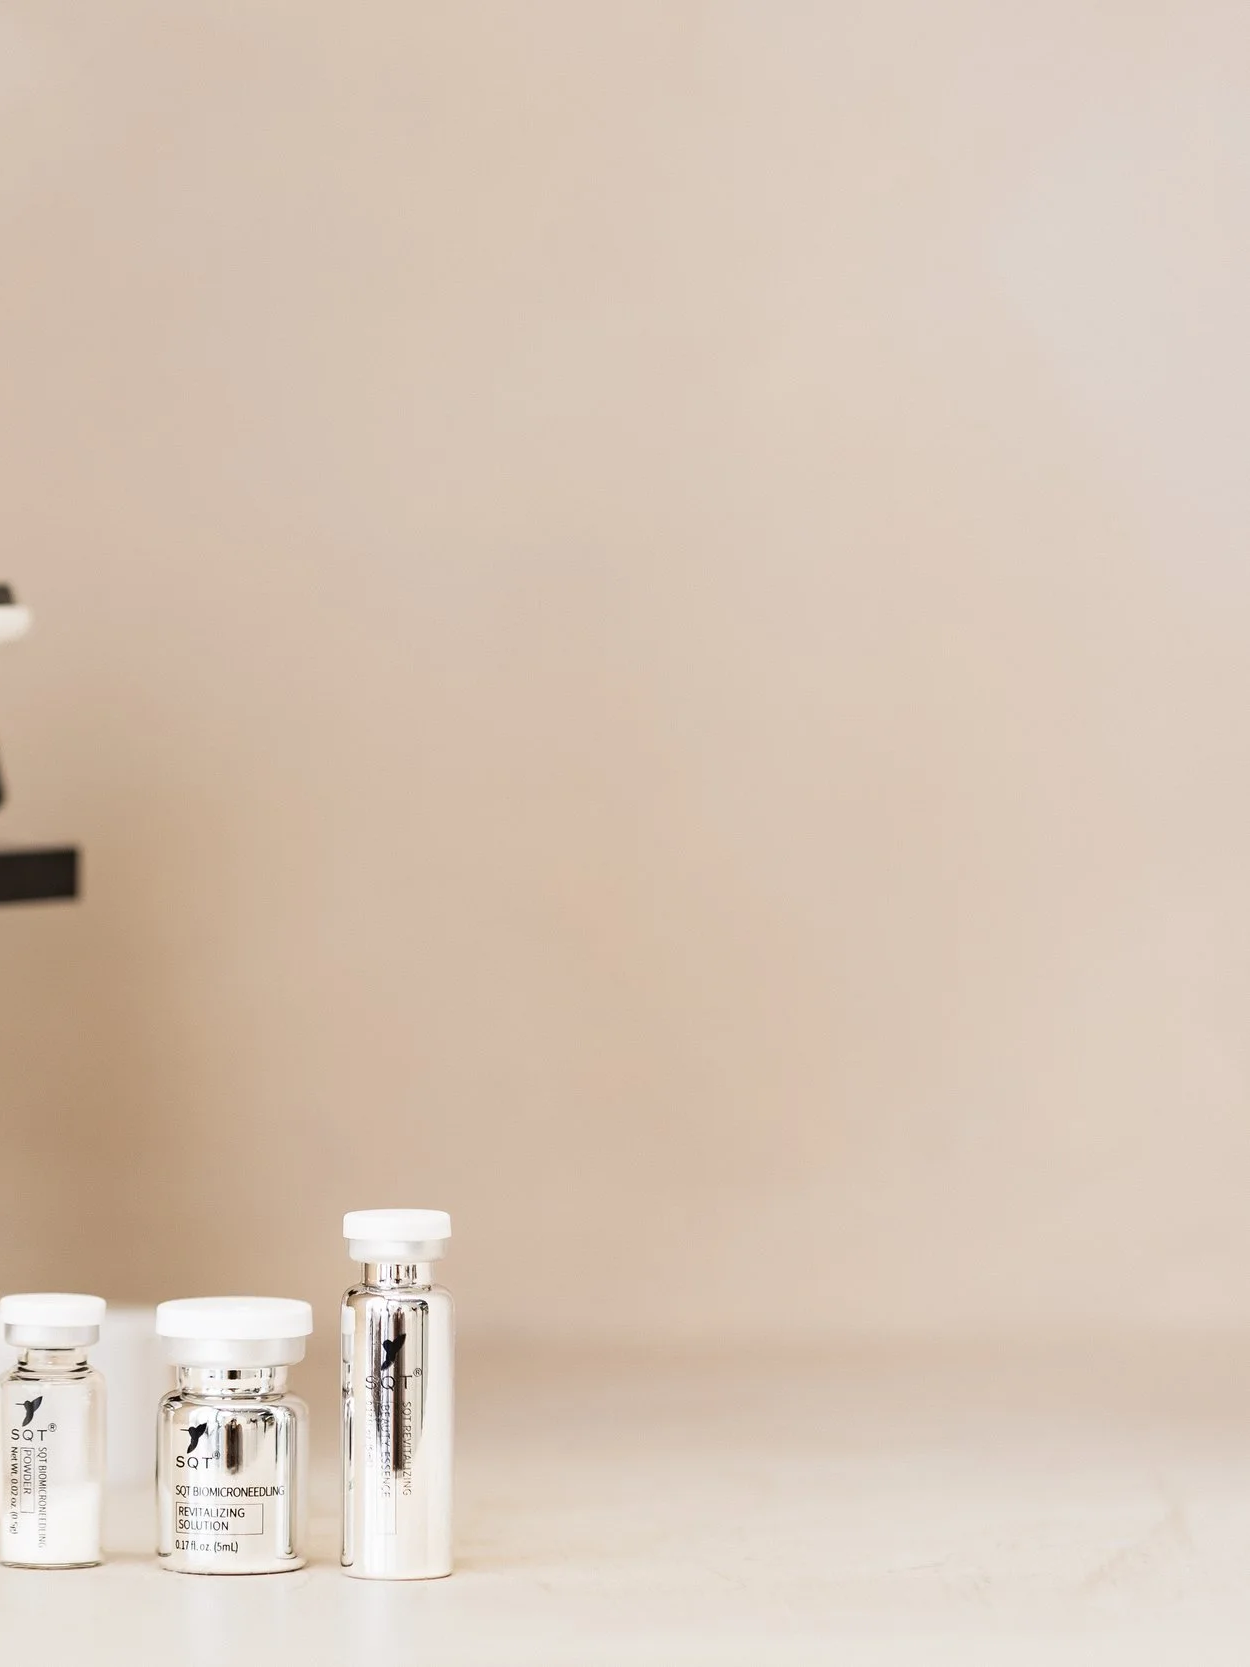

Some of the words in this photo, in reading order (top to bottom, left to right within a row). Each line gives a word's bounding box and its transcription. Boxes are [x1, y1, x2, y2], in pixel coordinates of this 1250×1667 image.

[10, 1446, 18, 1461] Net
[37, 1447, 48, 1463] SQT
[402, 1425, 412, 1496] REVITALIZING
[23, 1449, 32, 1495] POWDER
[10, 1478, 18, 1496] 0.02
[175, 1485, 190, 1498] SQT
[193, 1485, 285, 1497] BIOMICRONEEDLING
[178, 1506, 245, 1518] REVITALIZING
[178, 1519, 229, 1531] SOLUTION
[175, 1540, 190, 1550] 0.17
[214, 1541, 239, 1553] (5mL)
